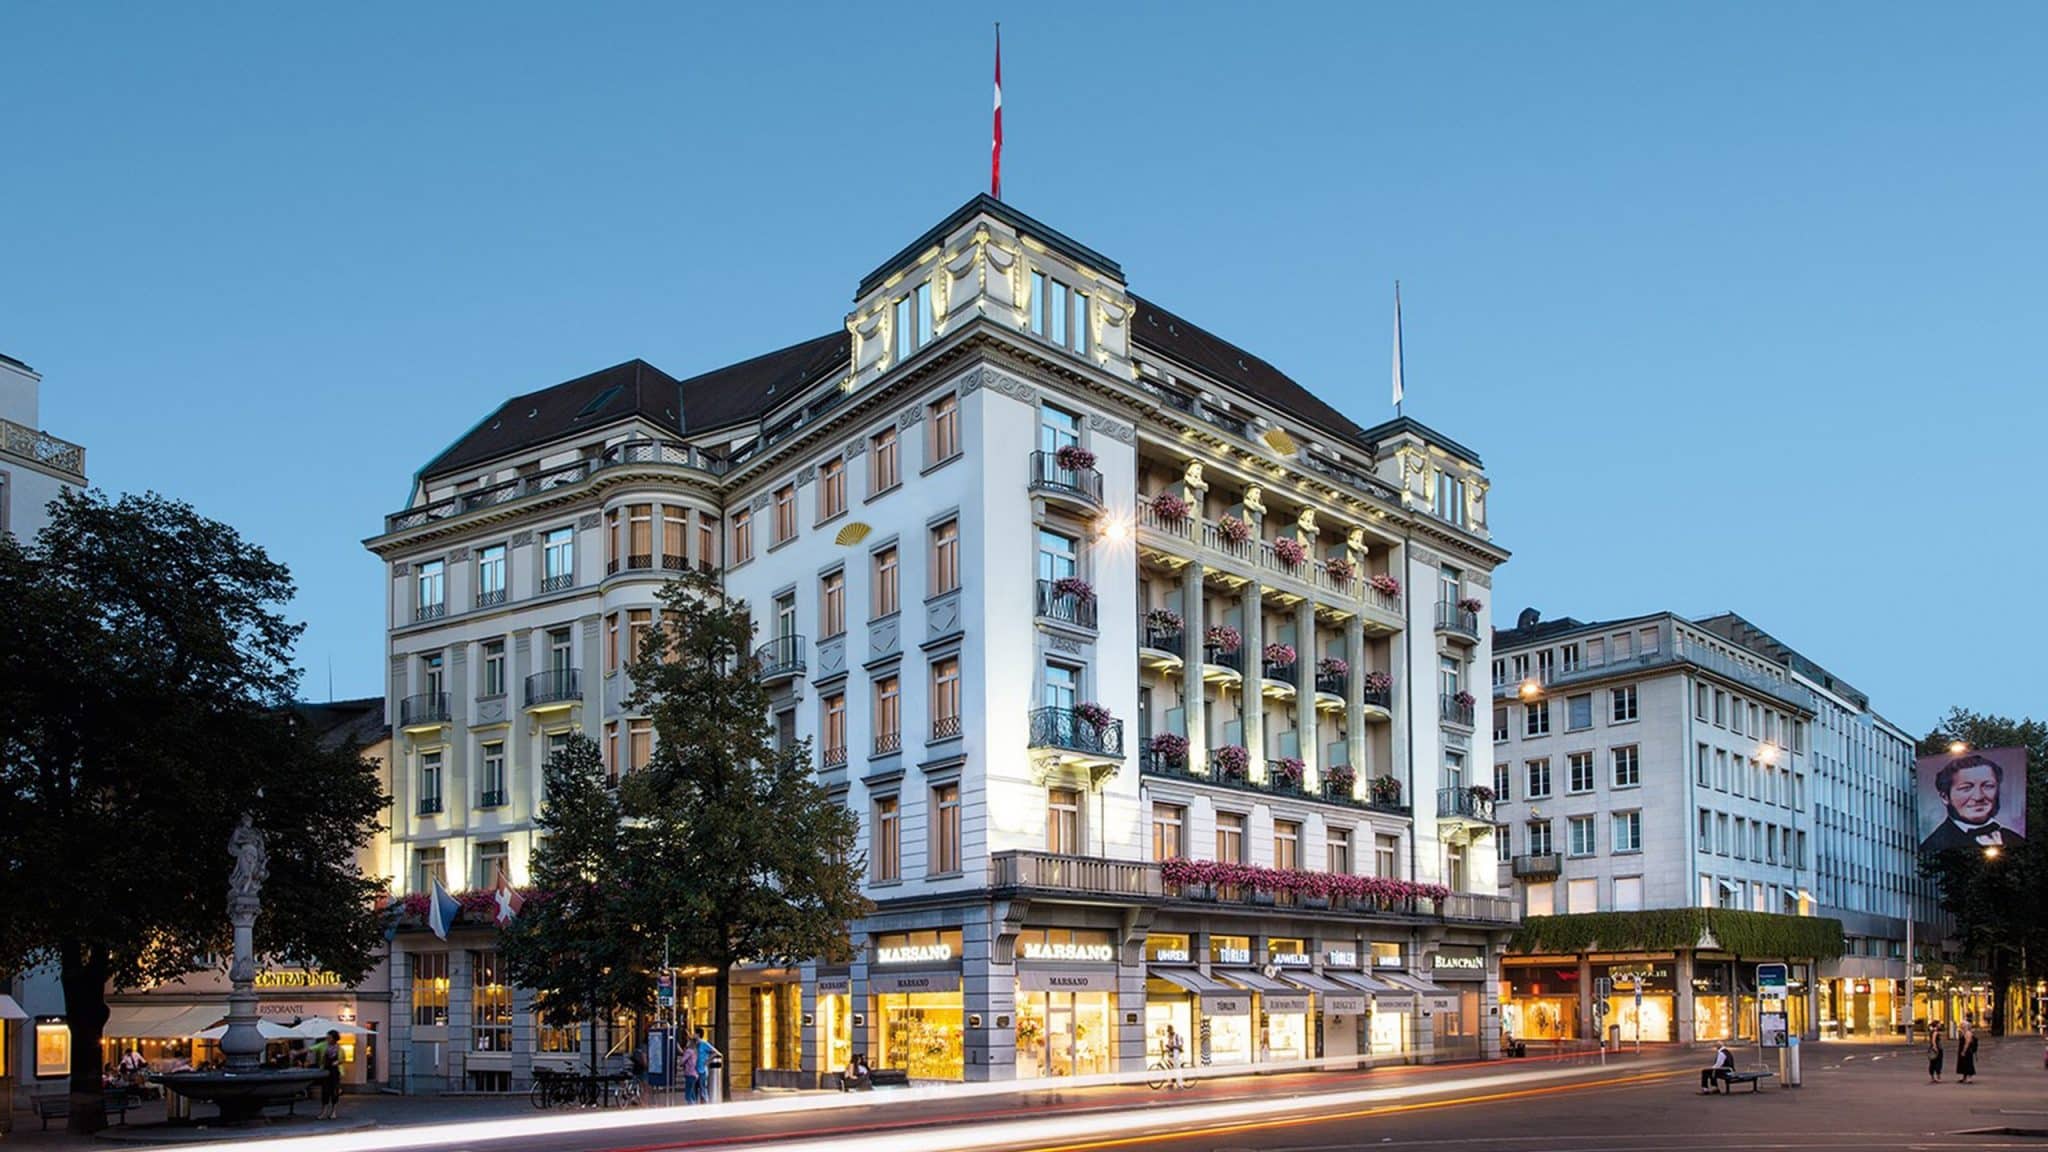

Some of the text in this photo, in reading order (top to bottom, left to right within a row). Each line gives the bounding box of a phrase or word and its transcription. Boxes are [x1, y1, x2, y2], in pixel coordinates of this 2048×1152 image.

[877, 944, 951, 963] MARSANO
[1023, 943, 1113, 961] MARSANO
[1157, 949, 1189, 961] UHREN
[1434, 955, 1483, 968] BLANCPAIN
[1049, 976, 1088, 986] MARSANO
[260, 1004, 304, 1014] RISTORANTE
